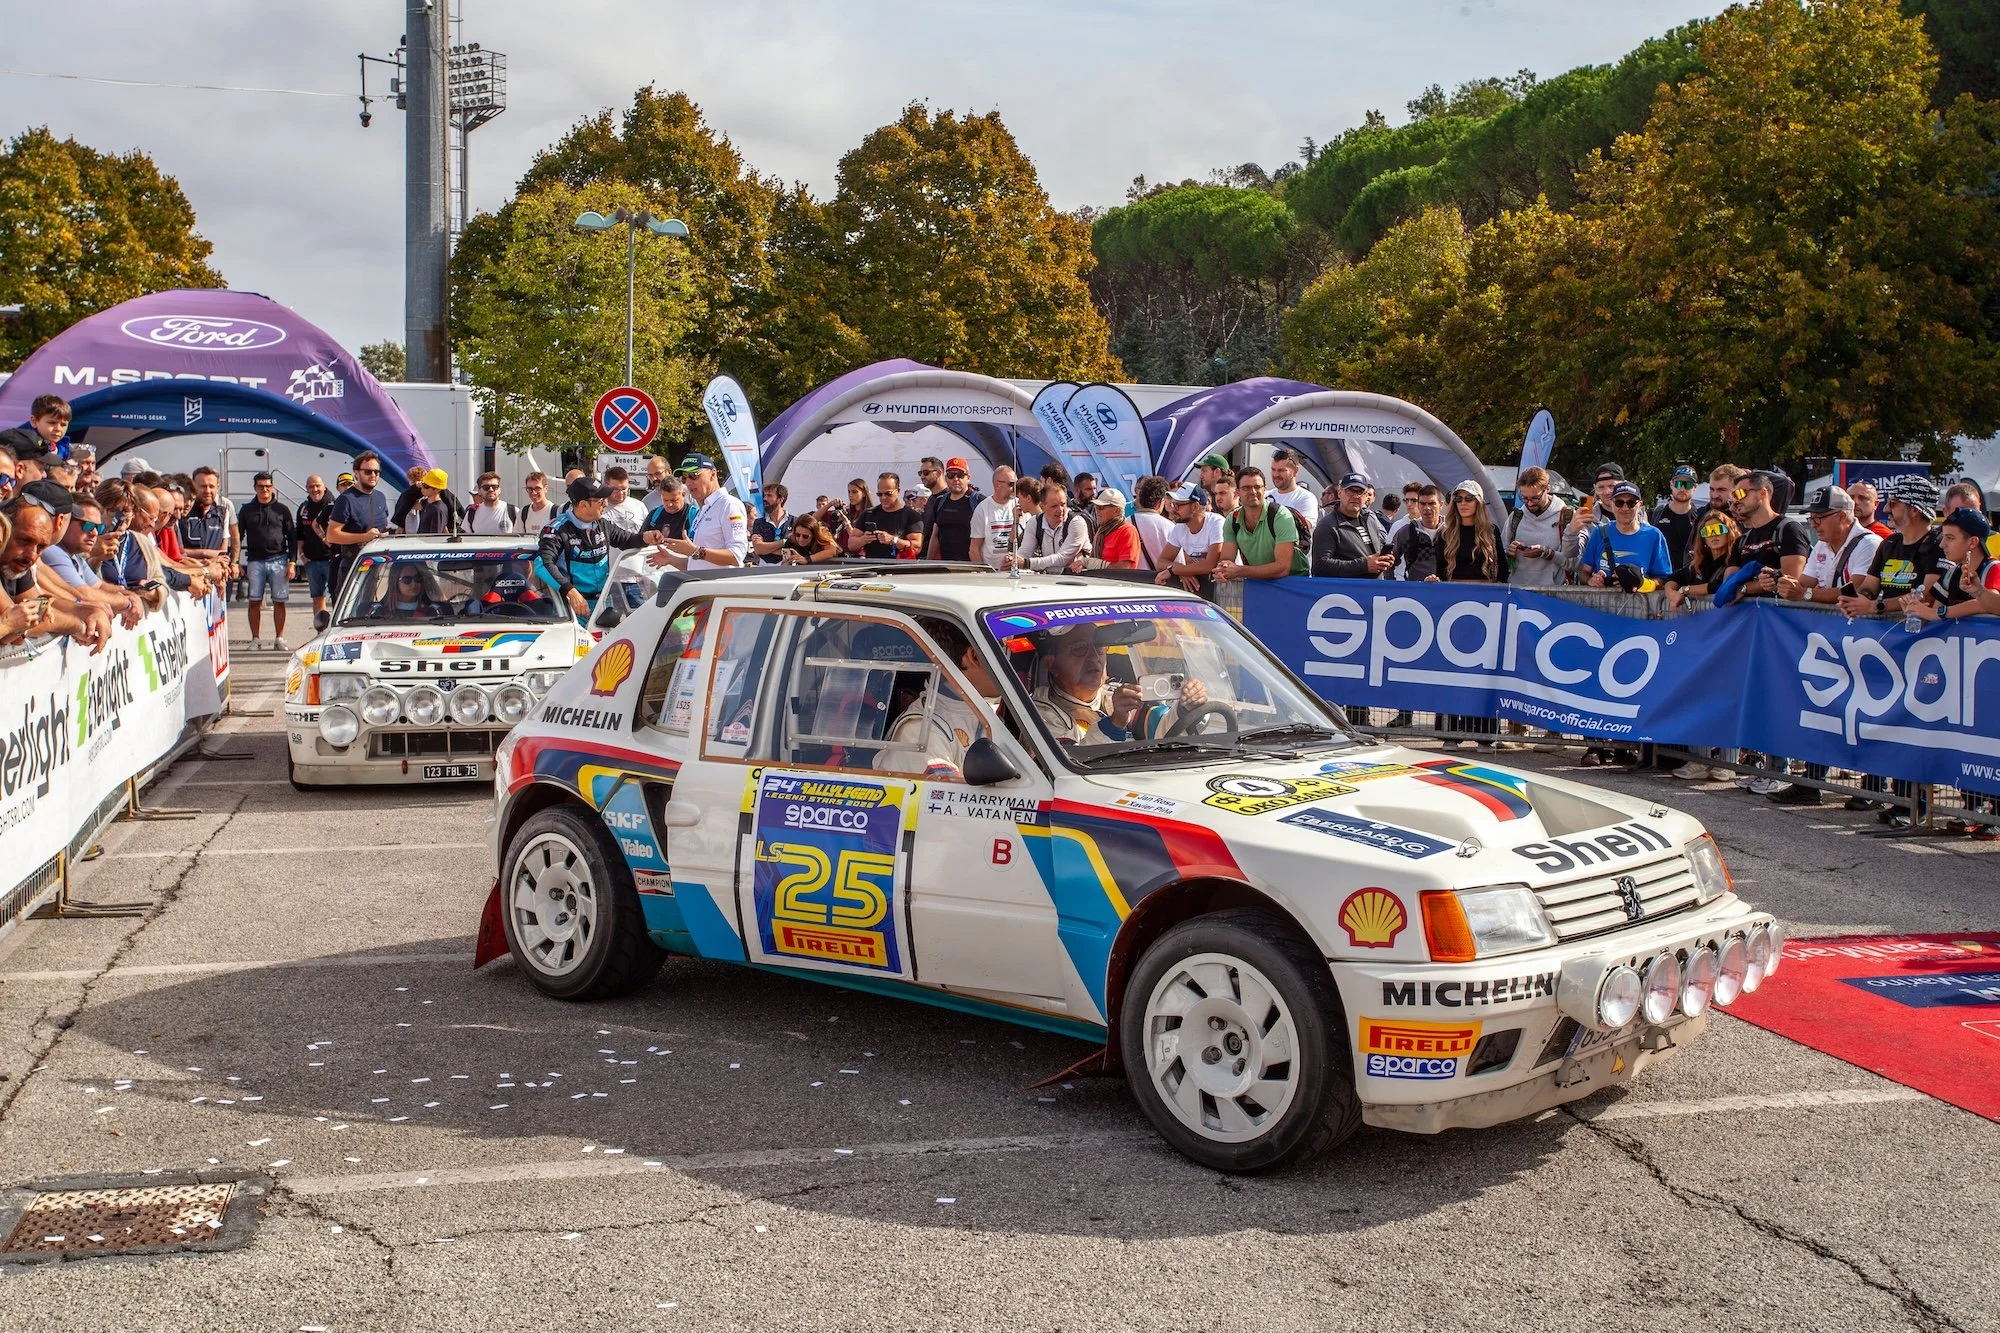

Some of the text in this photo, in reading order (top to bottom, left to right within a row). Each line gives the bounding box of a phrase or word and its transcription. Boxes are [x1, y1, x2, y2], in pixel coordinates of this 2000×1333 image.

[151, 318, 259, 346] Ford
[711, 395, 732, 437] HYUNDAI
[886, 404, 1014, 416] HYUNDAI MOTORSPORT
[1045, 402, 1074, 443] HYUNDAI
[1039, 406, 1066, 446] MOTORSPORT
[1073, 408, 1100, 447] MOTORSPORT
[1079, 404, 1108, 445] HYUNDAI
[1300, 421, 1417, 436] HYUNDAI MOTORSPORT
[1044, 604, 1195, 621] PEUGEOT TALBOT SPORT
[1304, 594, 1662, 700] sparco
[379, 659, 510, 673] Shell
[542, 706, 623, 732] MICHELIN
[676, 700, 691, 711] LS25
[1499, 697, 1633, 734] www.sparco-official.com
[426, 765, 477, 777] 123 FBL 75
[765, 792, 807, 802] LEGEND
[808, 796, 847, 806] STARS
[801, 782, 885, 801] RALLYLEGEND
[947, 792, 1036, 809] T. HARRYMAN
[1237, 781, 1273, 794] 4
[1238, 797, 1290, 815] OKO
[1289, 784, 1351, 804] BANK
[603, 811, 647, 829] SKF
[784, 804, 869, 832] sparco
[944, 805, 1033, 823] A. VATANEN
[1289, 814, 1403, 843] EBERHARD
[620, 838, 654, 859] Valeo
[991, 838, 1012, 865] B
[1511, 822, 1673, 874] Shell
[637, 876, 672, 888] CHAMPION
[756, 840, 895, 929] LS 25
[782, 926, 876, 958] PIRELLI
[1382, 971, 1554, 1007] MICHELIN
[1369, 1025, 1474, 1052] PIRELLI
[1369, 1055, 1456, 1077] sparco
